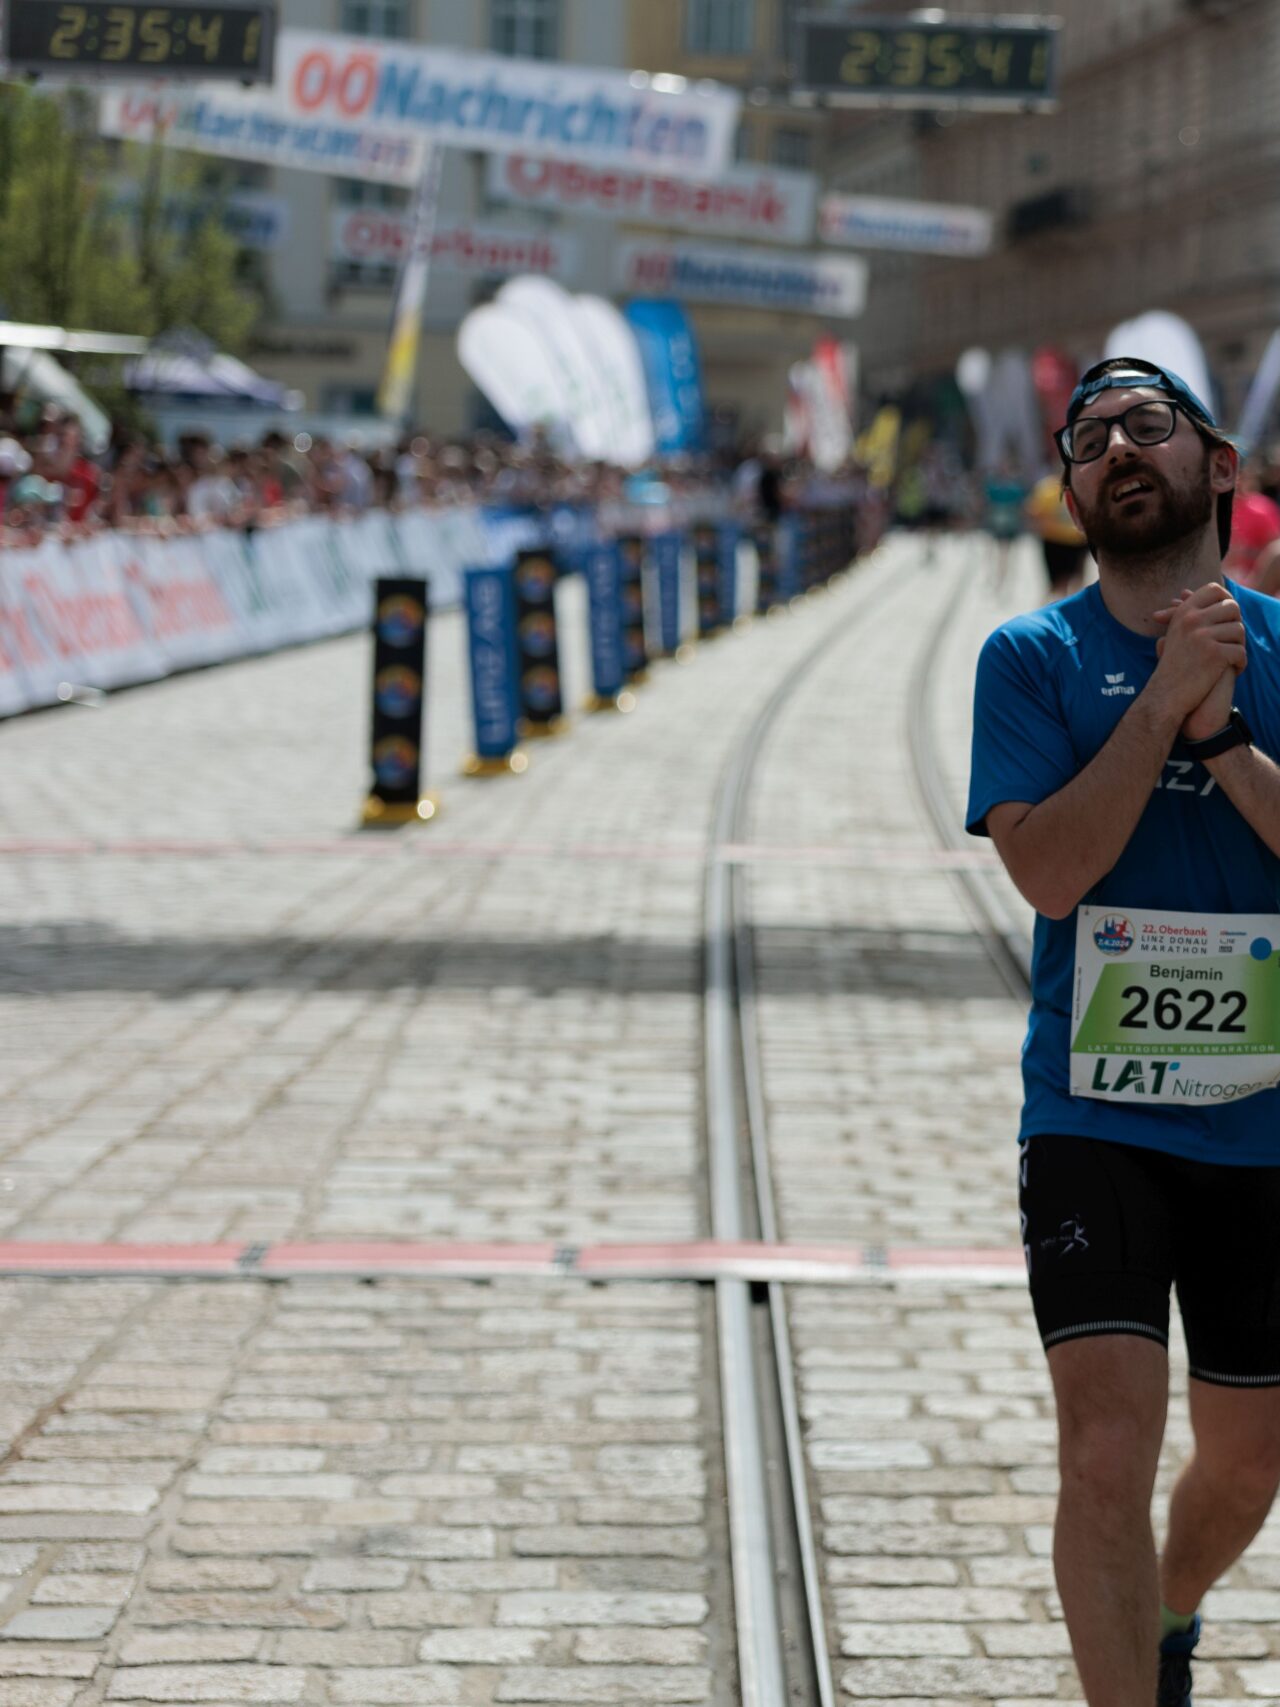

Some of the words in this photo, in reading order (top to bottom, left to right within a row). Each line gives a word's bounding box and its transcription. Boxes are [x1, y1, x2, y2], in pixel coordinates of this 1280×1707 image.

[1101, 685, 1135, 696] erima
[1142, 924, 1157, 935] 22.
[1159, 925, 1207, 936] Oberbank
[1141, 935, 1165, 943] LINZ
[1170, 937, 1208, 946] DONAU
[1141, 944, 1208, 954] MARATHON
[1150, 964, 1223, 981] Benjamin
[1119, 986, 1247, 1033] 2622
[1088, 1044, 1108, 1052] LAT
[1115, 1045, 1174, 1053] NITROGEN
[1180, 1044, 1275, 1053] HALBMARATHON
[1092, 1057, 1169, 1095] LAT
[1173, 1078, 1262, 1100] Nitrogen
